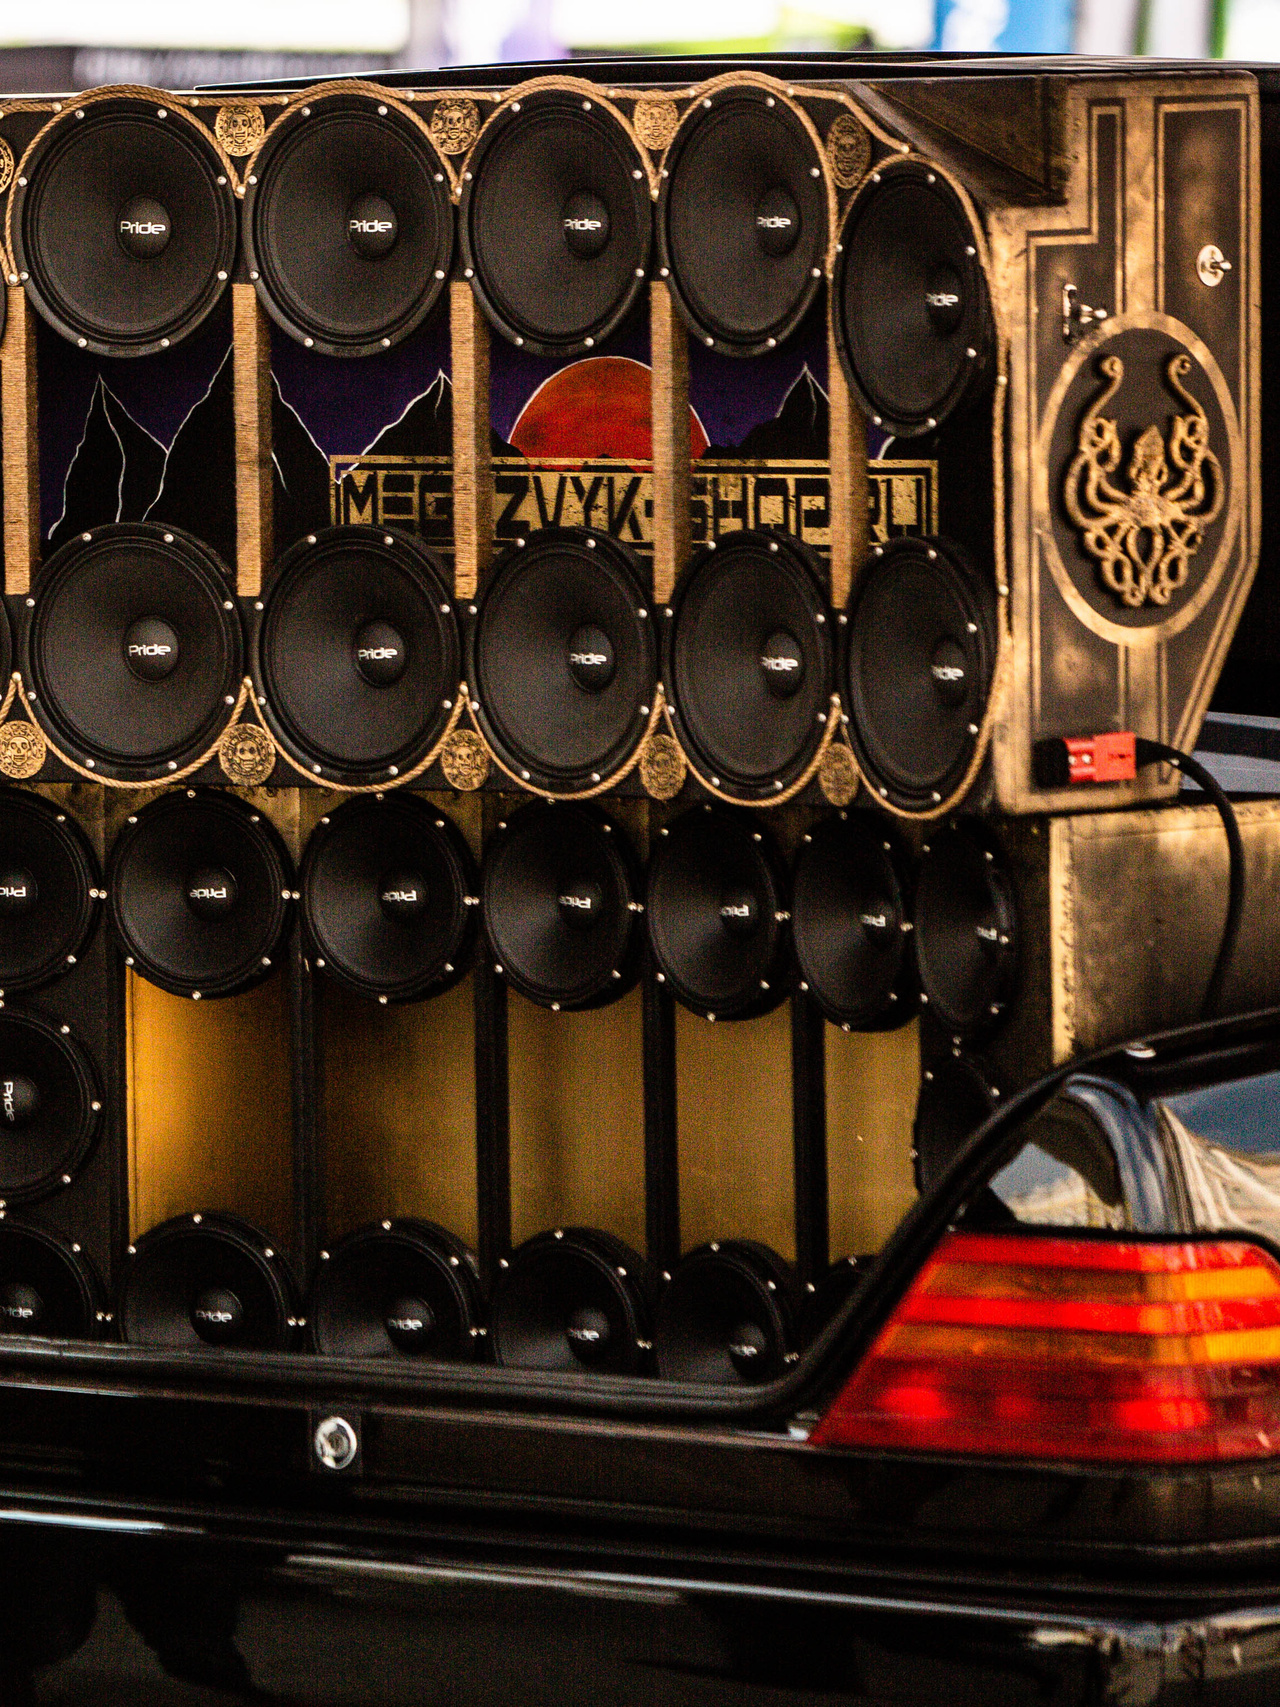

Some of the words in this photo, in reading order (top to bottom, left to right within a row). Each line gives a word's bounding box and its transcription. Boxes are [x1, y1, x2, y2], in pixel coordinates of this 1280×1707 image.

[120, 221, 166, 235] Pride
[350, 220, 393, 233] Pride
[564, 218, 601, 231] Pride
[128, 644, 171, 656] Pride
[358, 647, 398, 660] Pride
[570, 653, 606, 665] Pride
[189, 887, 226, 900] Pride
[382, 889, 417, 902] Pride
[3, 1081, 14, 1121] Pride
[0, 1306, 33, 1319] ride
